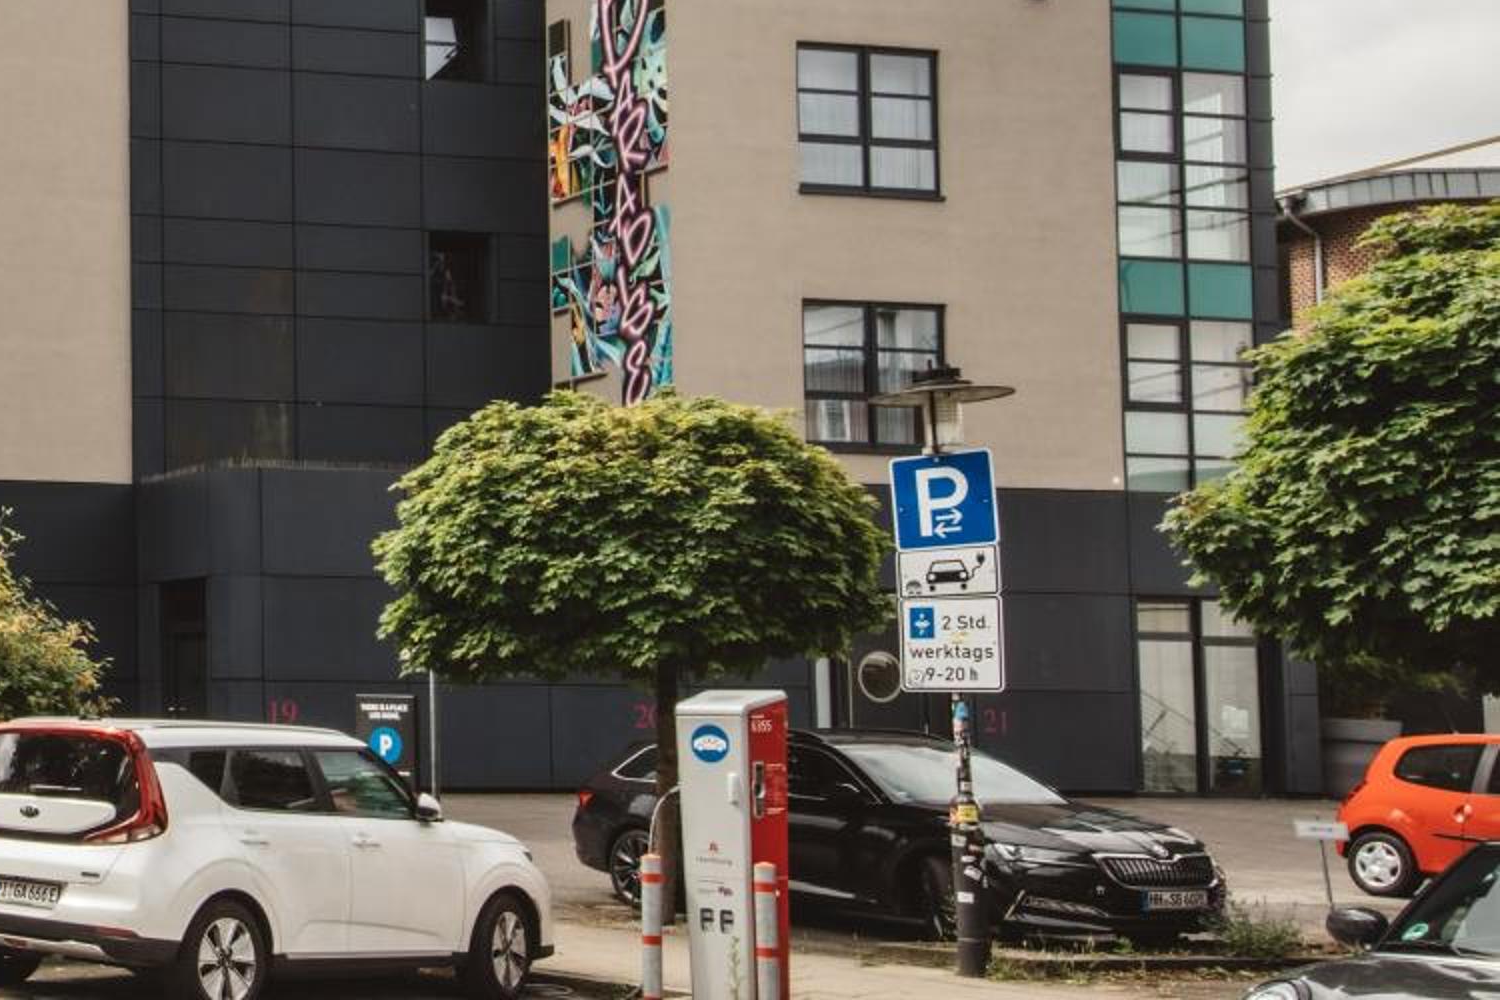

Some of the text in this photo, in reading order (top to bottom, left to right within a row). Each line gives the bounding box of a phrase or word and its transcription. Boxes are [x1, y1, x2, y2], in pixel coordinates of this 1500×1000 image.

[916, 466, 968, 536] P
[942, 615, 991, 631] 2 Std.
[910, 644, 994, 662] werktags
[925, 667, 965, 681] 9-20
[268, 697, 299, 726] 19
[380, 734, 393, 757] P
